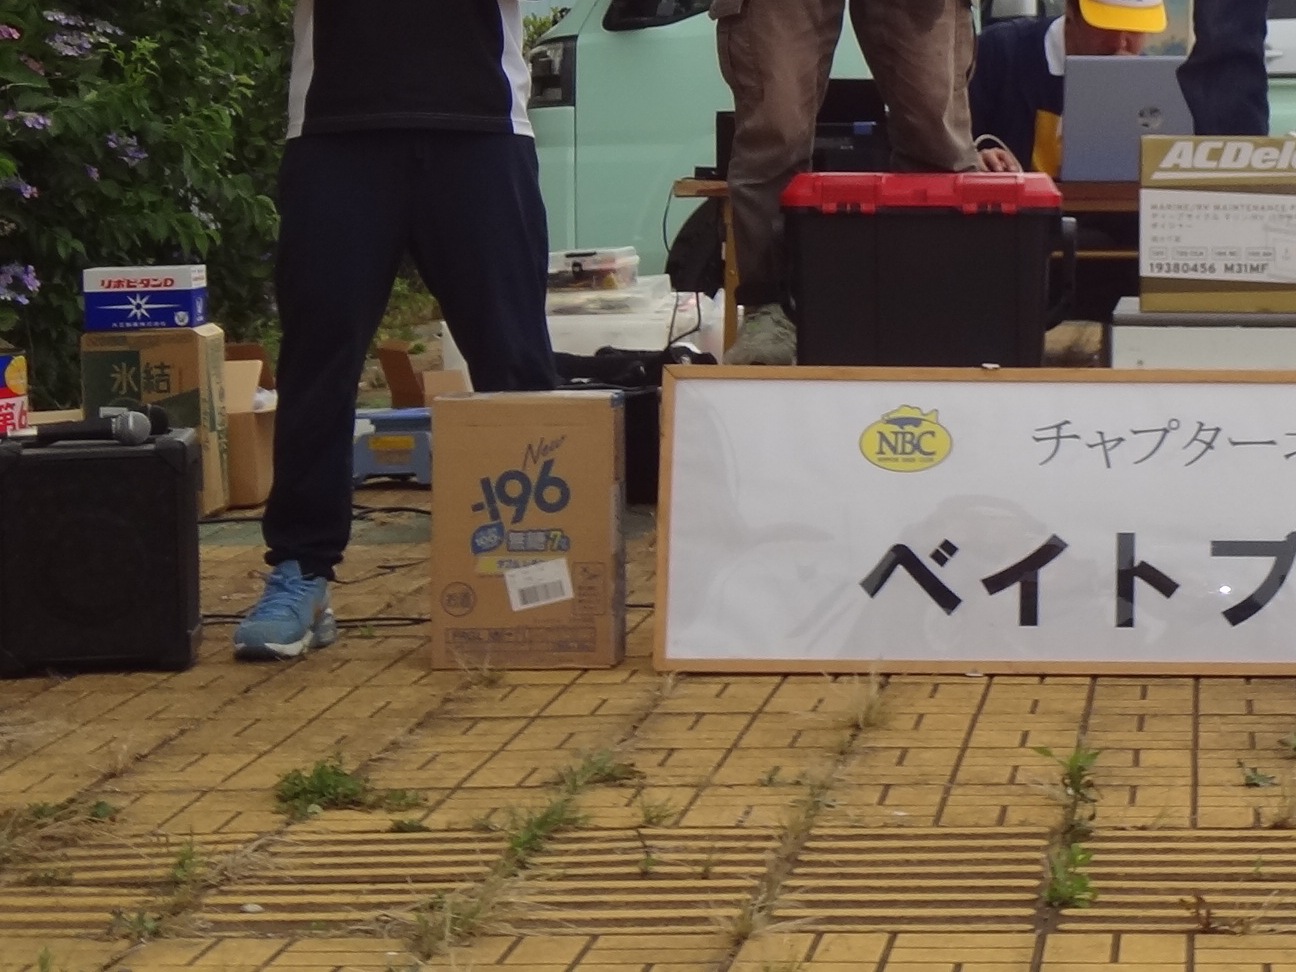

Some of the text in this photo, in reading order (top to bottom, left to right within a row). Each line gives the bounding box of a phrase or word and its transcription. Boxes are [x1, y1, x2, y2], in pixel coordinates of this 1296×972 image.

[1149, 262, 1270, 274] 19380456 M31MF
[100, 277, 175, 289] リポビタンD
[110, 362, 172, 394] 氷結
[523, 434, 567, 470] New
[875, 430, 936, 456] NBC
[471, 458, 571, 525] -196
